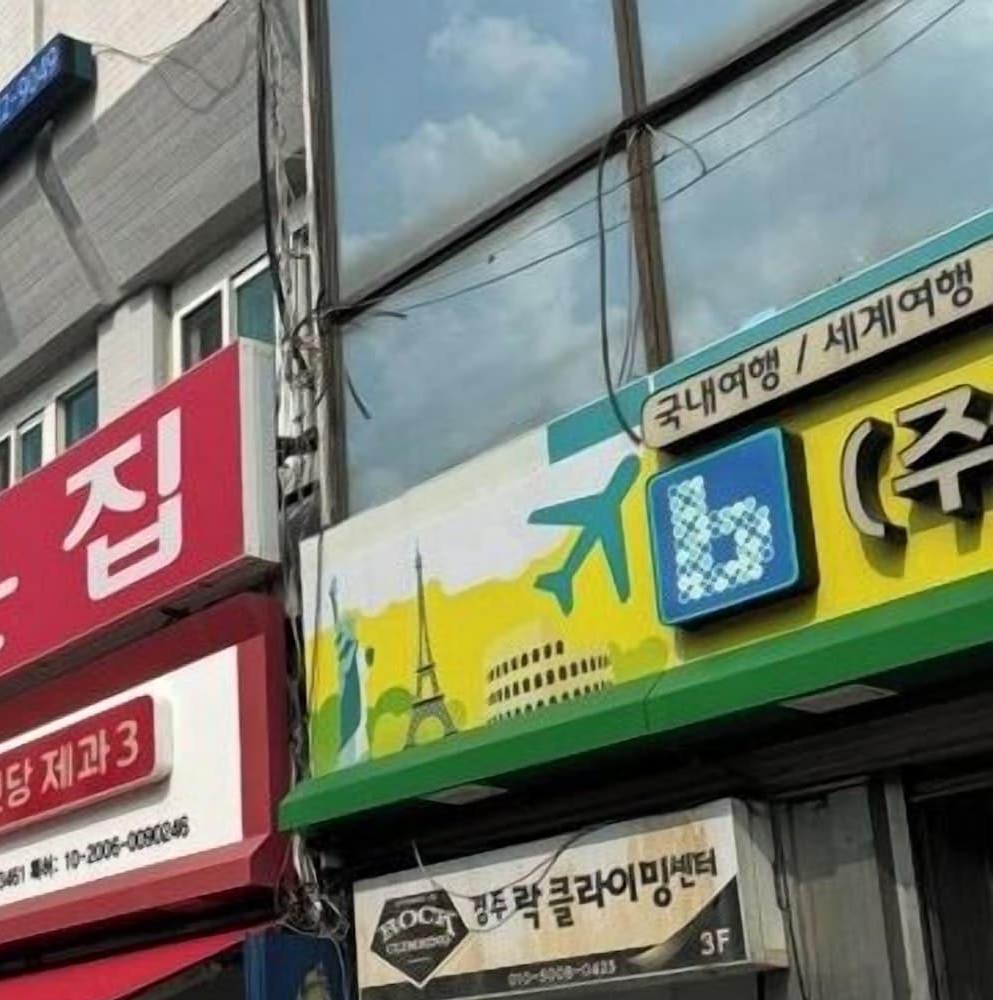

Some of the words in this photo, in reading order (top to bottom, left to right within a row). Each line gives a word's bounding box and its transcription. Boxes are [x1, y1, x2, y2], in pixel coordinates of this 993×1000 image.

[655, 345, 780, 431] 국내여행
[823, 259, 973, 352] 세계여행
[62, 406, 183, 601] 집
[699, 928, 731, 957] 3F
